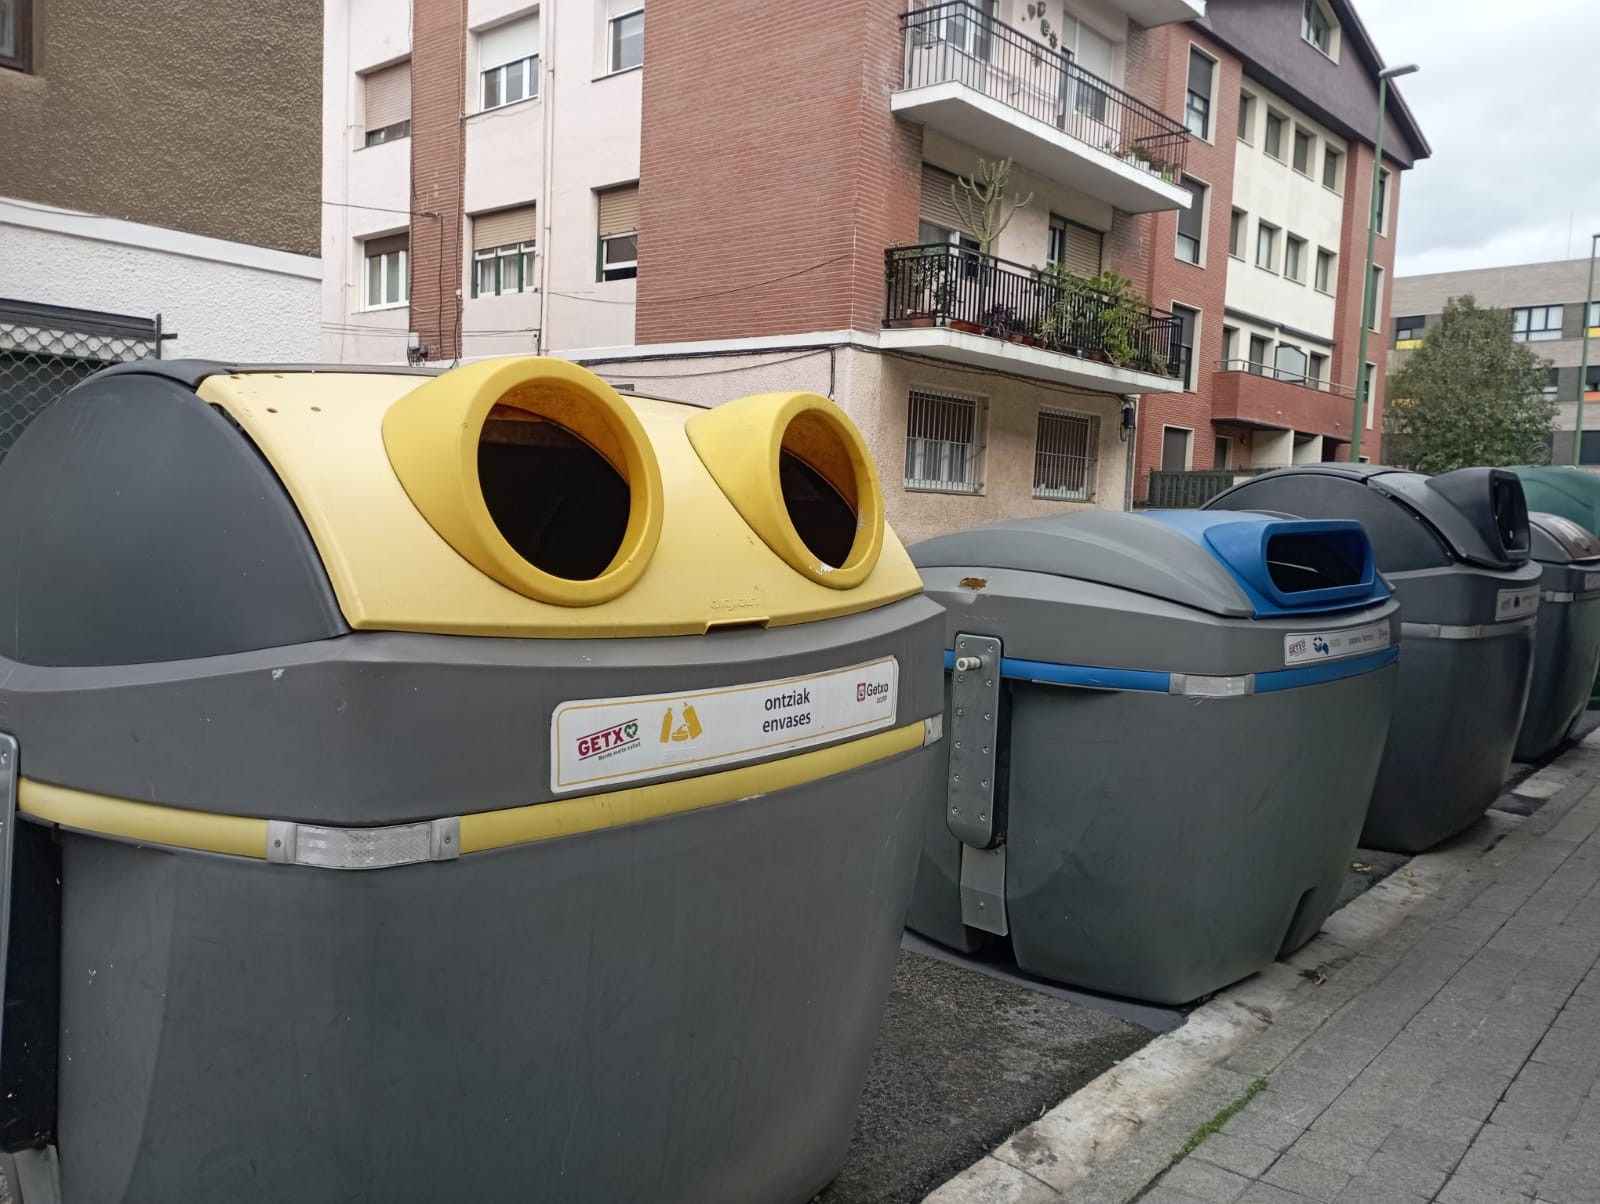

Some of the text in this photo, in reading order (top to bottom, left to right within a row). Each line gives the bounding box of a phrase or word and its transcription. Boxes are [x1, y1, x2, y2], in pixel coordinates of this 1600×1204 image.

[764, 687, 811, 711] ontziak
[866, 682, 889, 697] Getxo
[762, 711, 812, 733] envases
